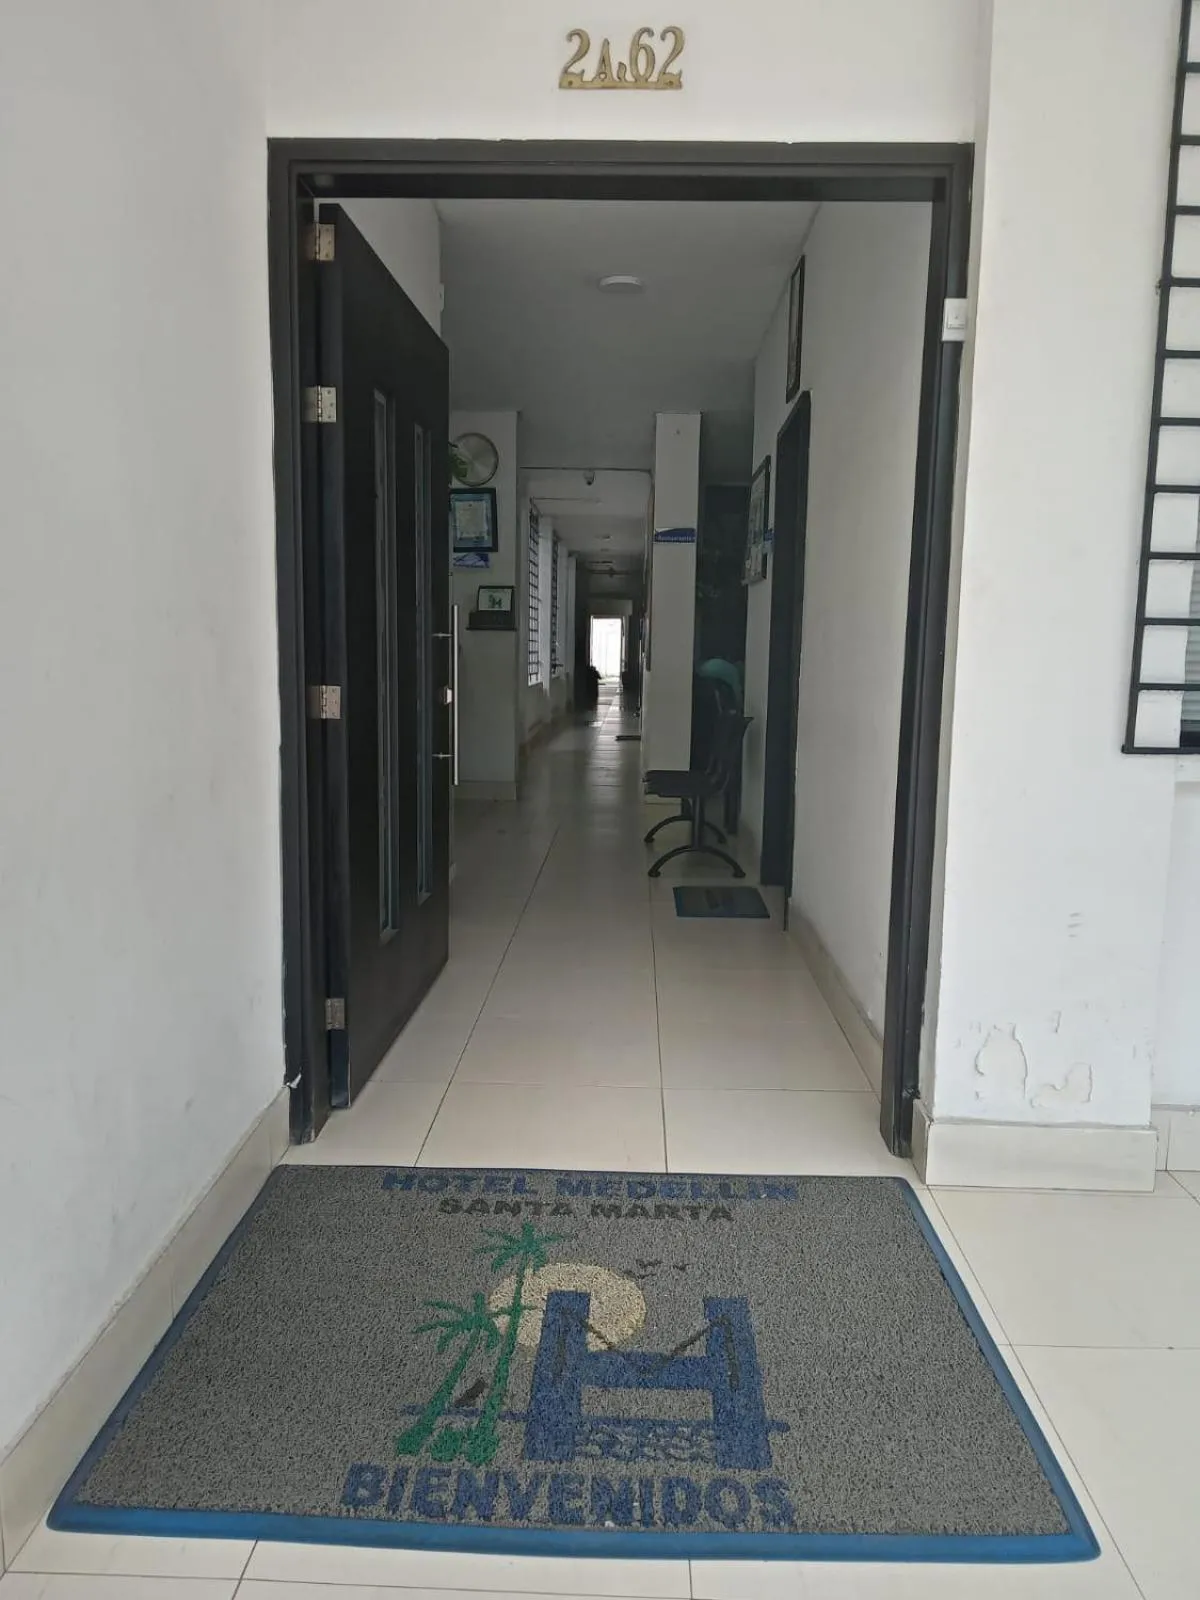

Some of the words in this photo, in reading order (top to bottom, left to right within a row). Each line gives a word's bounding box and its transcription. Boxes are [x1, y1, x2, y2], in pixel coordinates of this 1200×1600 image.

[381, 1172, 539, 1195] HOTEL
[555, 1178, 798, 1202] MEDELLIN
[439, 1200, 576, 1216] SANTA
[591, 1203, 735, 1222] MARTA
[342, 1462, 797, 1531] BIENVENIDOS
